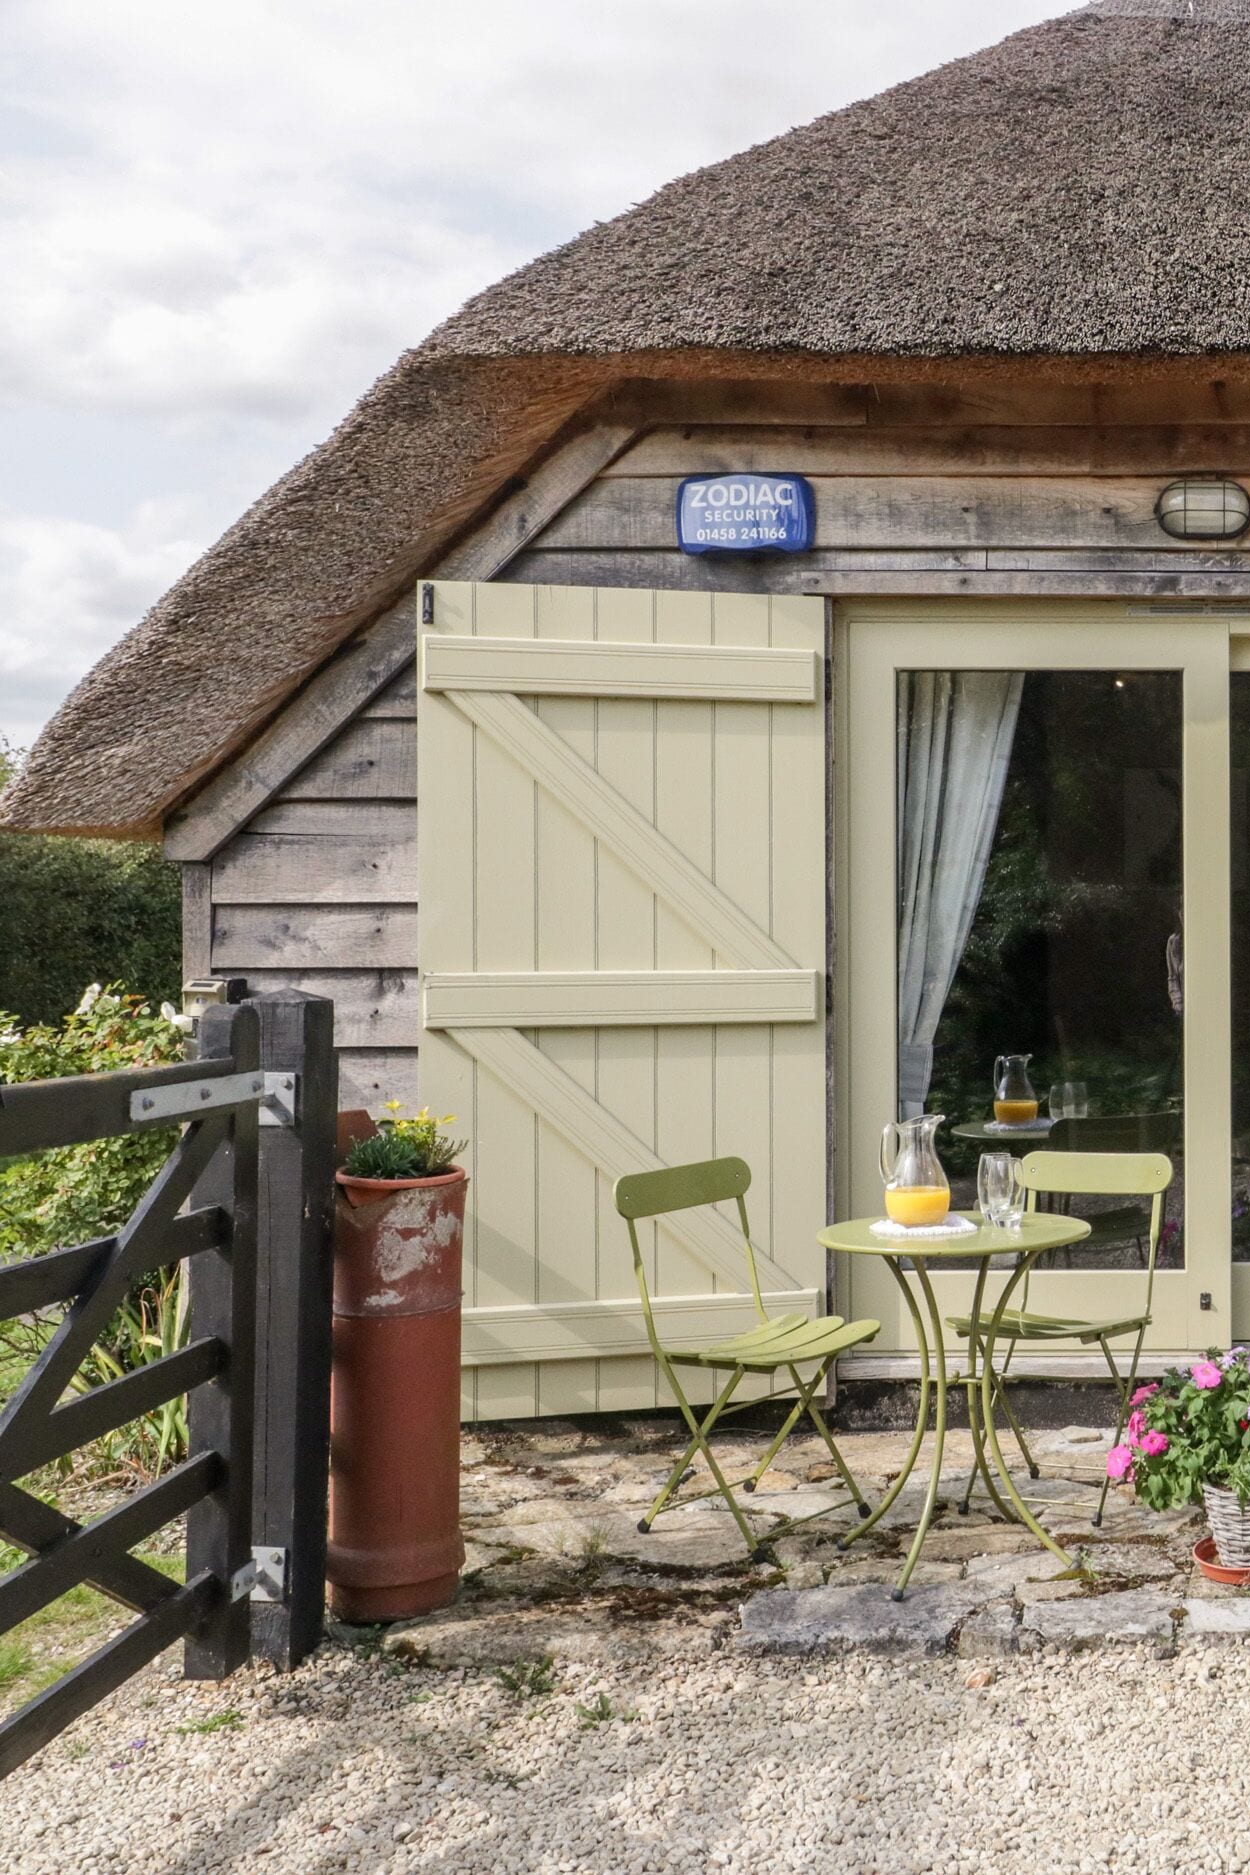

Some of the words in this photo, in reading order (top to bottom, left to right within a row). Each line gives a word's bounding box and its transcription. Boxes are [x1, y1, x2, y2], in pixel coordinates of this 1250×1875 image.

[690, 483, 793, 507] ZODIAC
[704, 508, 779, 522] SECURITY
[696, 529, 736, 541] 01458
[741, 527, 787, 539] 241166
